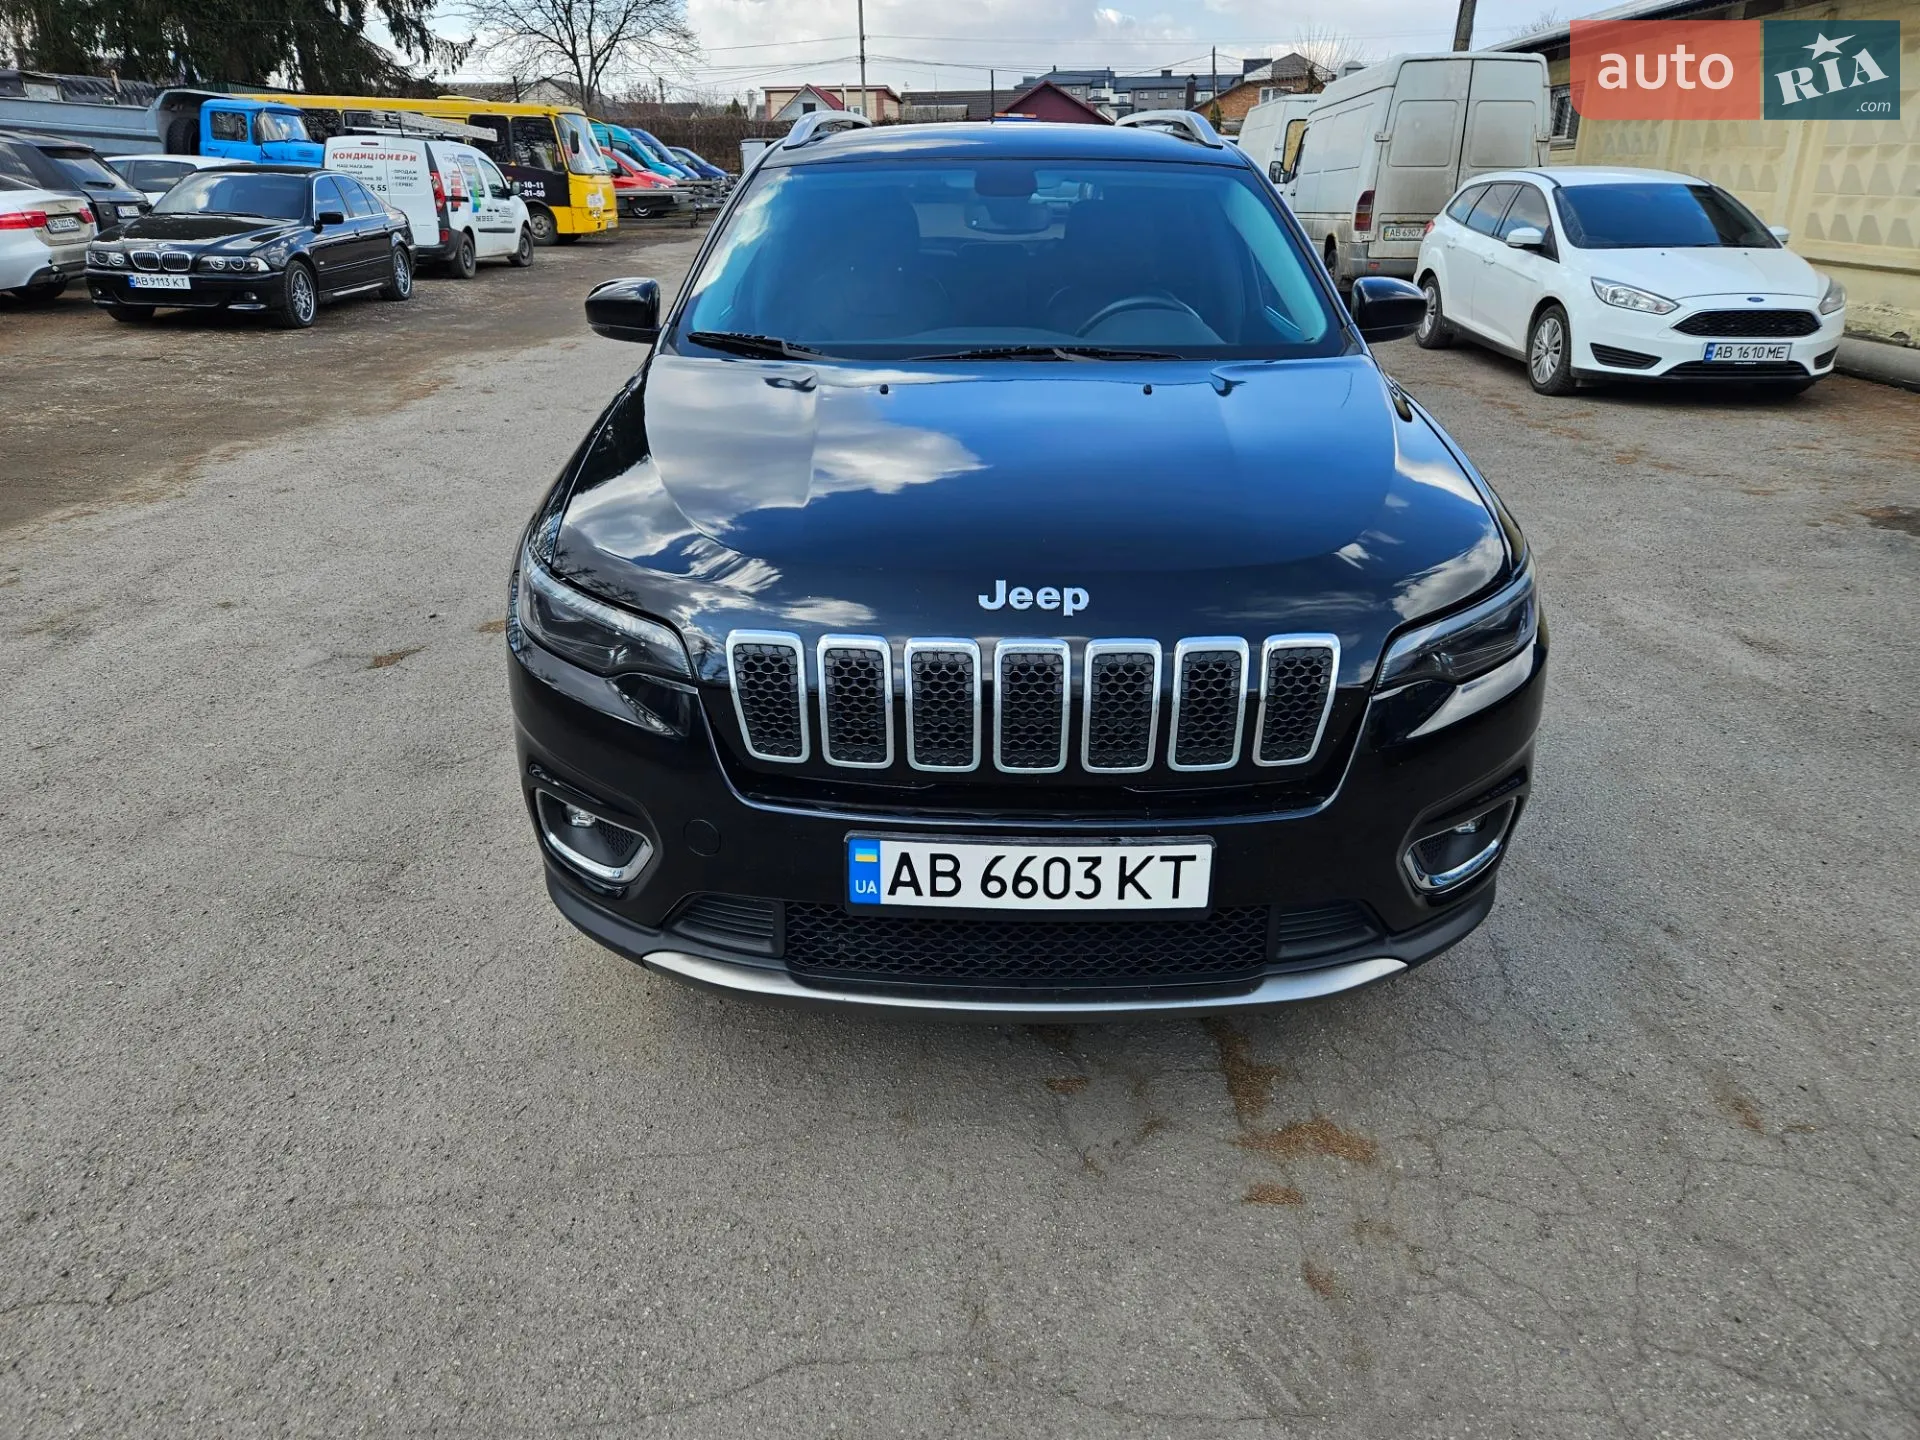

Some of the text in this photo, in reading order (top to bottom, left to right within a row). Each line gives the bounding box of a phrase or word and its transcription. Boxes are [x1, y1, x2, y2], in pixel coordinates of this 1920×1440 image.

[332, 153, 417, 162] КОНДИЦІОНЕРИ
[377, 184, 387, 192] 55
[1390, 229, 1401, 237] AB
[135, 276, 186, 287] AB 9113 KT
[1714, 346, 1786, 359] AB 1610 ME
[978, 579, 1090, 616] Jeep
[887, 851, 1197, 900] AB 6603 KT
[855, 880, 877, 894] UA
